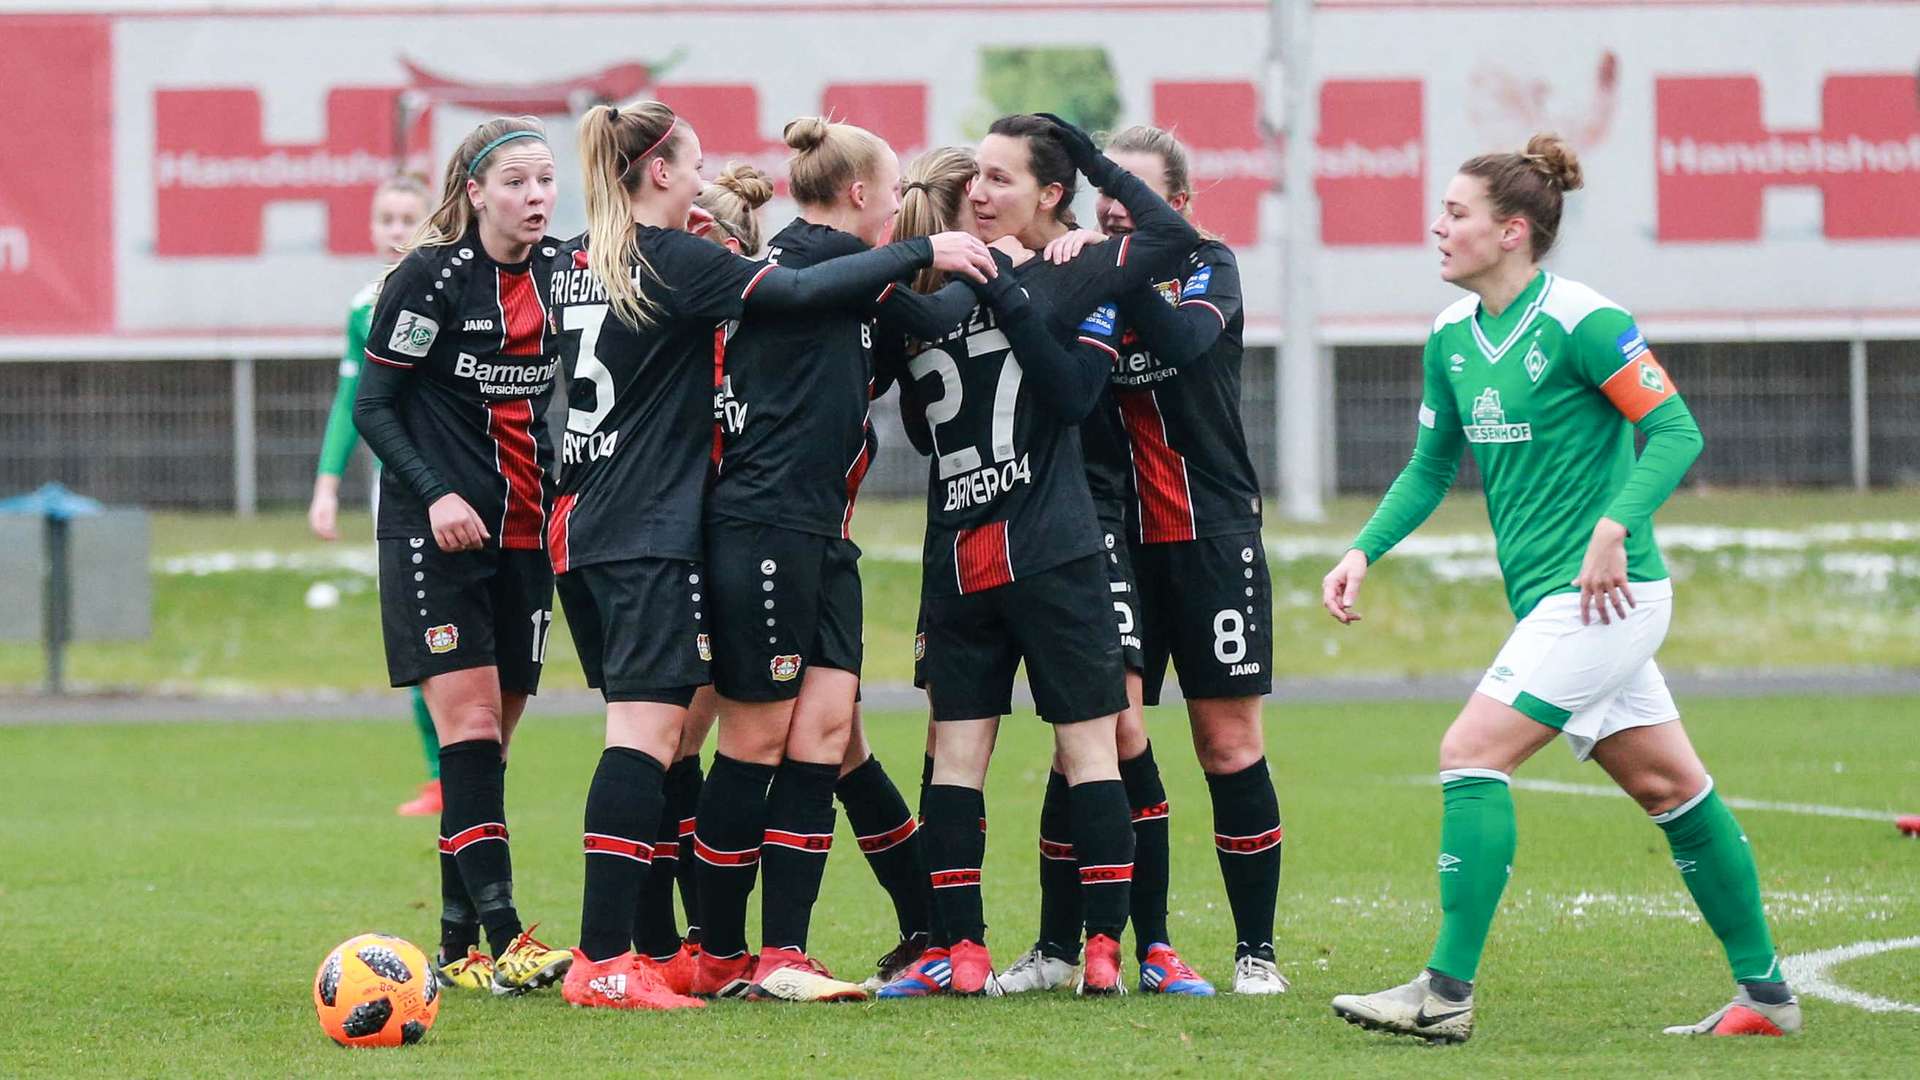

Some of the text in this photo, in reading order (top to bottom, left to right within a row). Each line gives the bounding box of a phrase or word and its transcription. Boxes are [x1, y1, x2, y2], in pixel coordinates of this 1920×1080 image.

[462, 319, 493, 331] JAKO
[563, 304, 616, 435] 3
[908, 328, 1023, 480] 27
[1213, 609, 1247, 664] 8
[1229, 662, 1260, 676] JAKO
